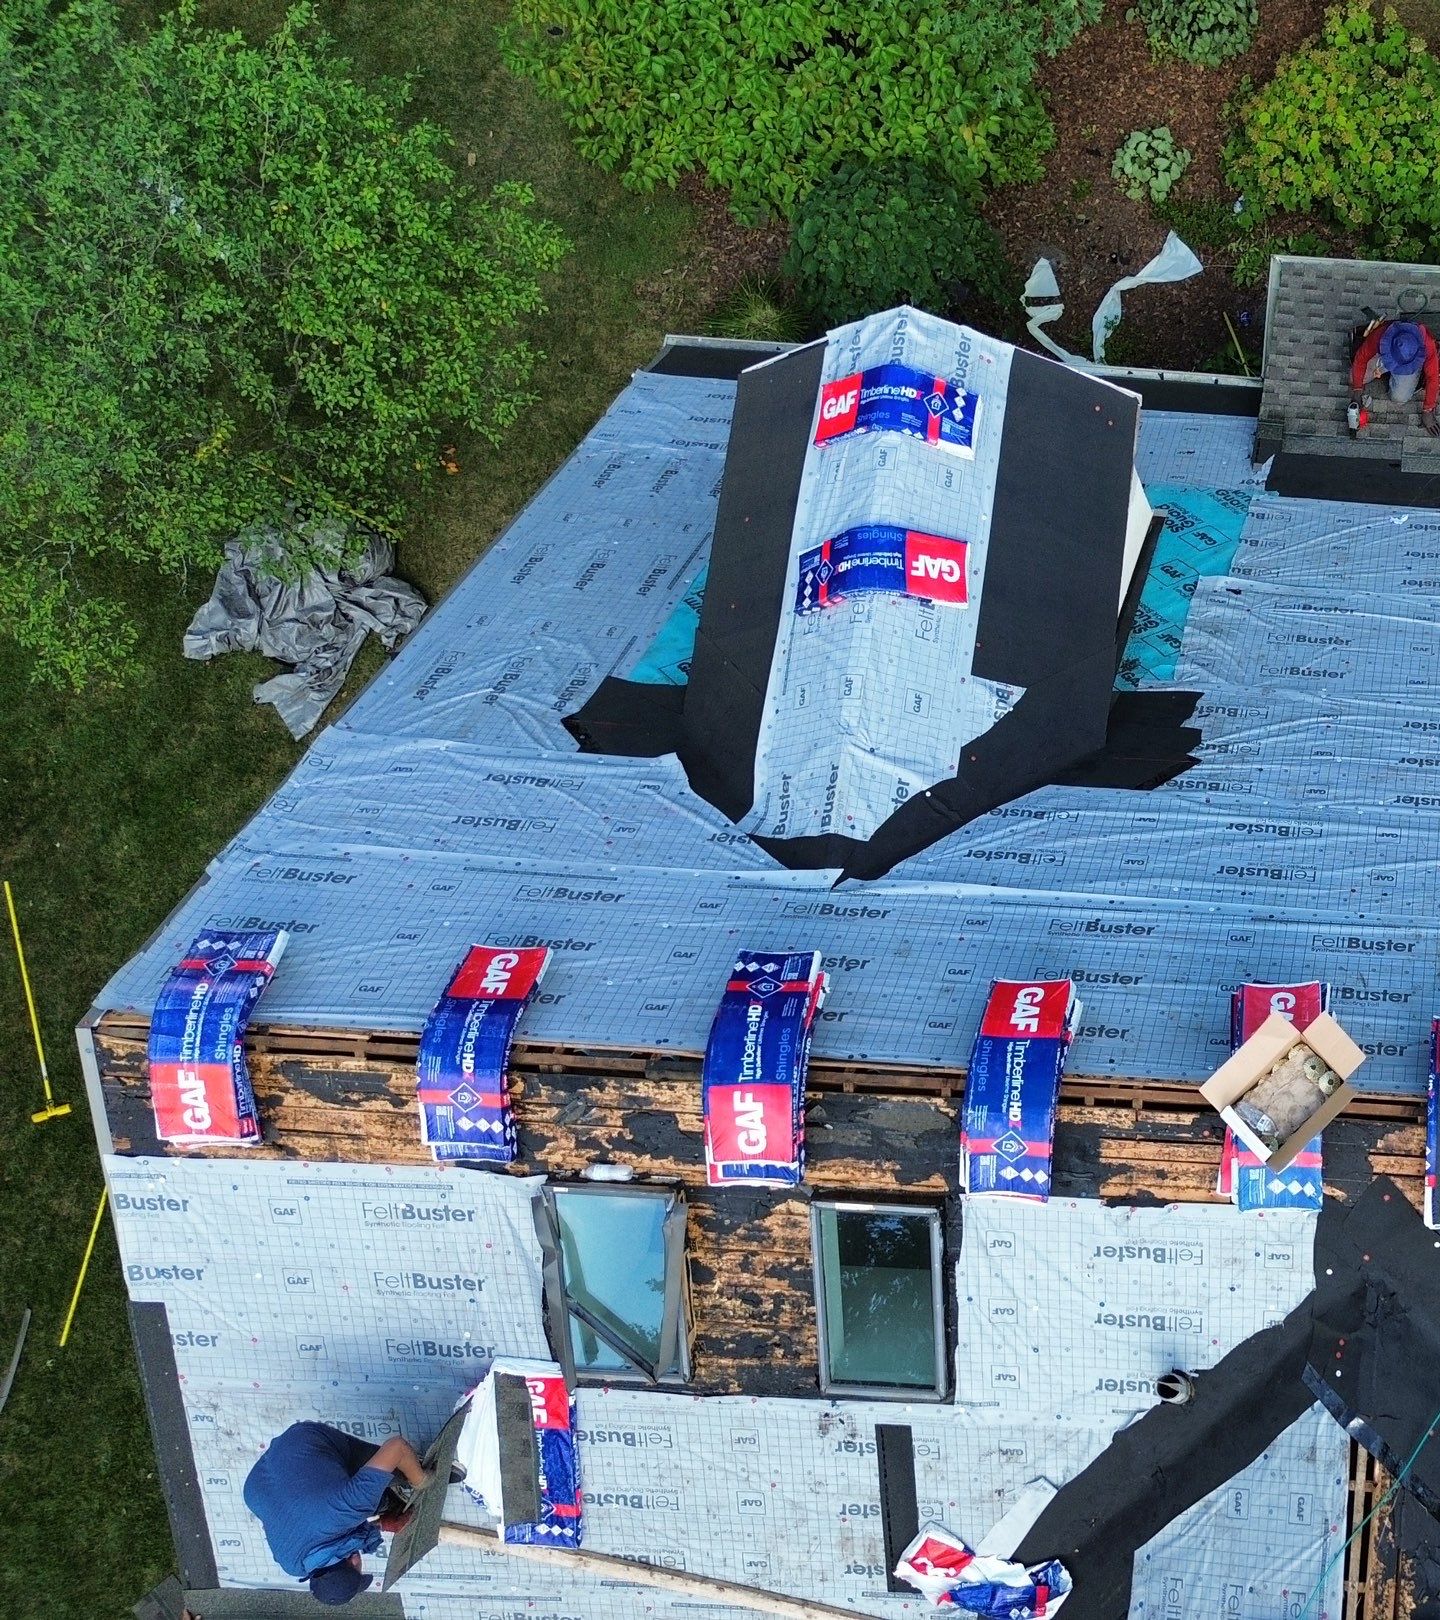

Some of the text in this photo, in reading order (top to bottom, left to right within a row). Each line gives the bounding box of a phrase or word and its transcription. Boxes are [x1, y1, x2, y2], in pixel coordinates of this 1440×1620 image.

[951, 333, 972, 389] Buster
[823, 391, 857, 419] GAF
[857, 530, 903, 542] Shingles
[910, 554, 960, 582] GAF
[776, 773, 792, 835] Buster
[246, 864, 356, 885] FeltBuster
[1220, 864, 1315, 883] FeltBuster
[516, 884, 625, 904] FeltBuster
[783, 901, 891, 920] FeltBuster
[205, 914, 320, 934] FeltBuster
[1049, 918, 1155, 938] FeltBuster
[486, 932, 596, 953] FeltBuster
[1312, 934, 1415, 953] FeltBuster
[481, 953, 517, 995] GAF
[1034, 967, 1144, 986] FeltBuster
[1012, 987, 1039, 1031] GAF
[179, 1070, 211, 1131] GAF
[735, 1091, 766, 1155] GAF
[361, 1202, 475, 1222] FeltBuster
[1094, 1245, 1203, 1265] FeltBuster
[375, 1271, 485, 1292] FeltBuster
[1094, 1311, 1203, 1333] FeltBuster
[385, 1339, 495, 1360] FeltBuster
